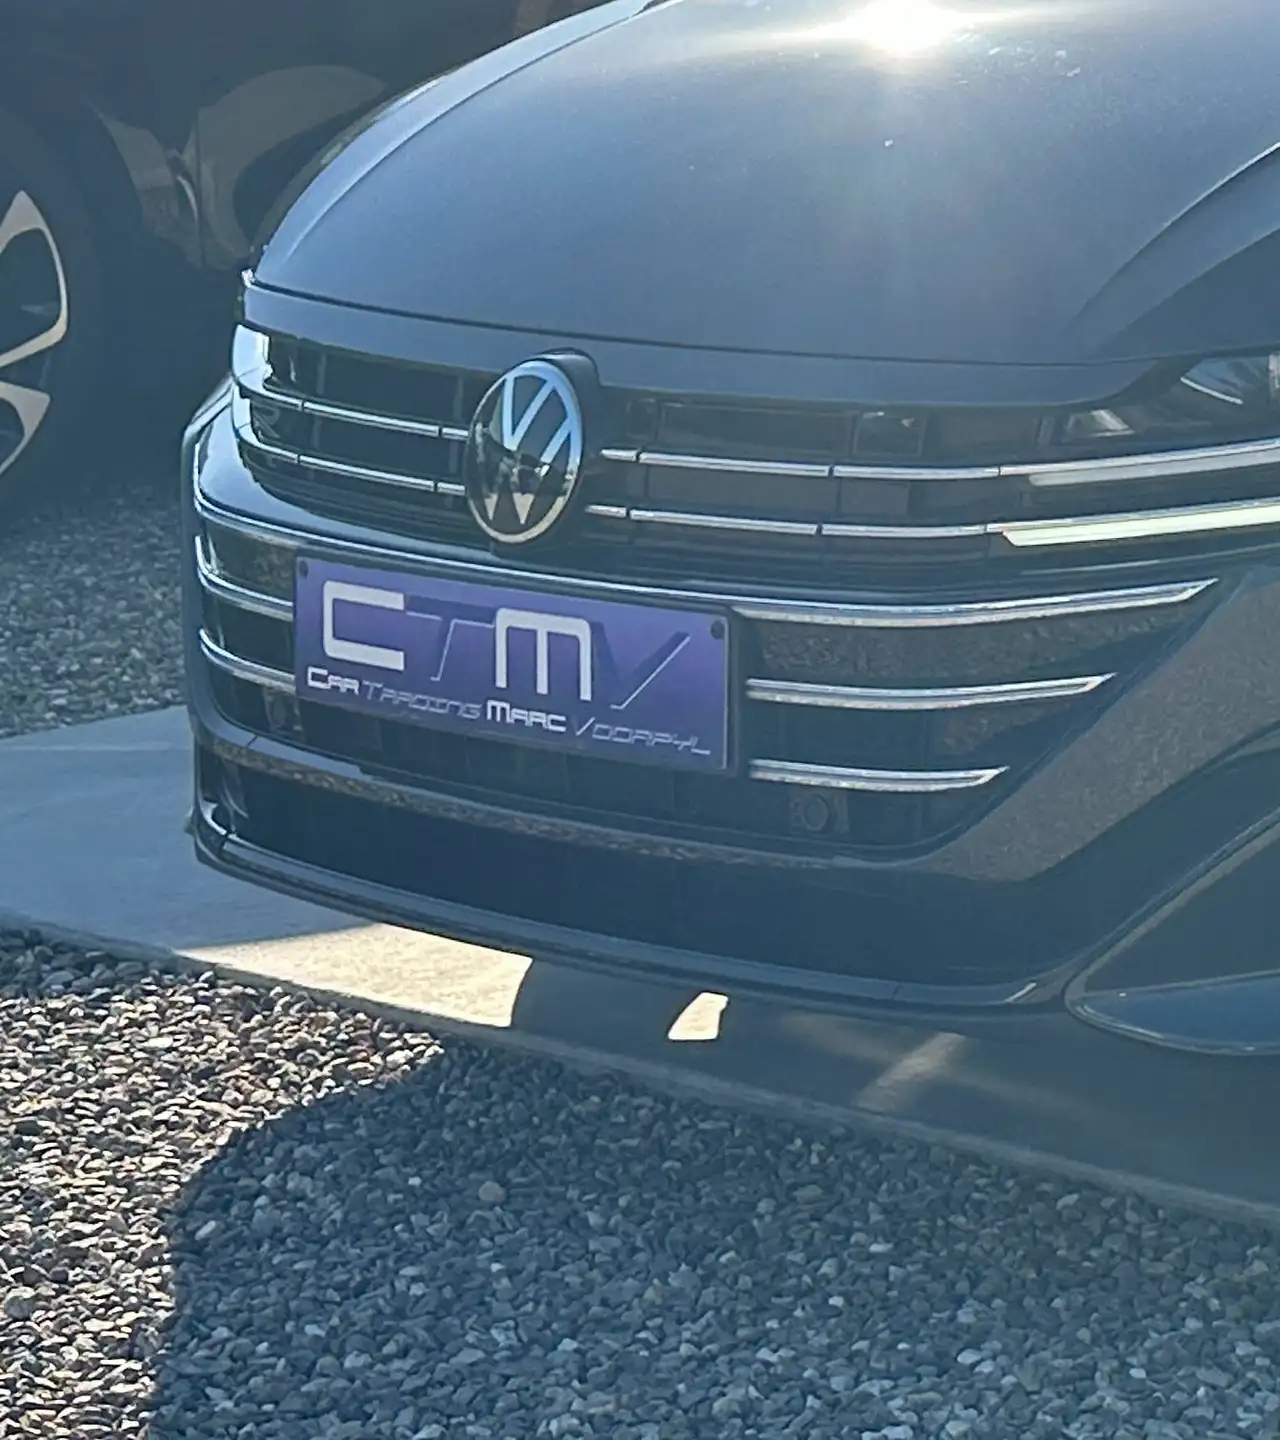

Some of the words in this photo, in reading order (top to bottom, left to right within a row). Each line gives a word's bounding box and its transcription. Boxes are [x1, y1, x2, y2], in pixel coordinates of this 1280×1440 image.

[322, 579, 692, 710] CTMV
[306, 665, 361, 696] CAR
[361, 679, 482, 720] TRADING
[486, 698, 567, 733] MARC
